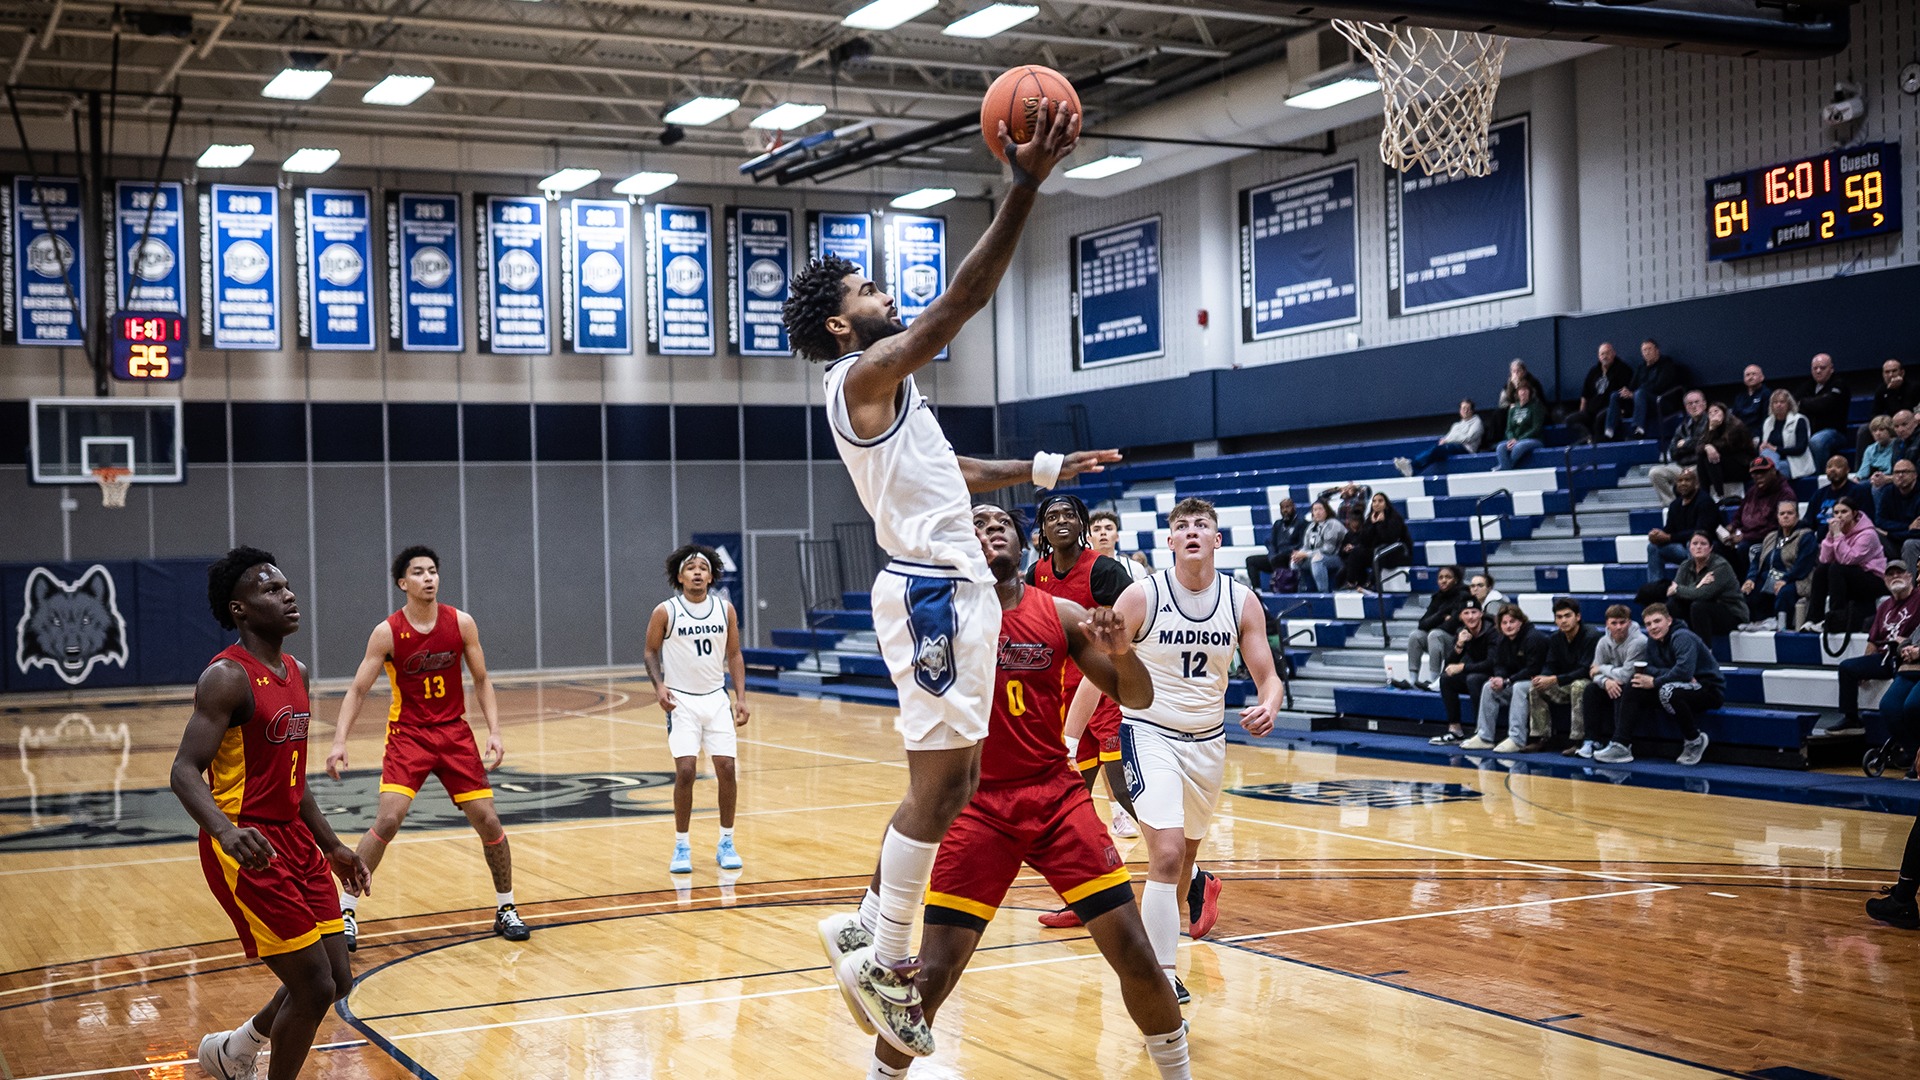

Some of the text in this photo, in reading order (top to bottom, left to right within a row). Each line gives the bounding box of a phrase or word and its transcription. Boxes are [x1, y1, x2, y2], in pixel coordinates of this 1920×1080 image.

[1840, 152, 1880, 174] Guests
[1713, 179, 1742, 199] Home
[1765, 159, 1831, 205] 16:01
[1845, 170, 1883, 214] 58
[1714, 199, 1749, 238] 64
[1821, 210, 1835, 239] 2
[1777, 221, 1810, 246] period
[129, 344, 169, 378] 25
[678, 625, 724, 636] MADISON
[1159, 630, 1231, 646] MADISON
[694, 639, 712, 656] 10
[1181, 651, 1208, 678] 12
[423, 675, 446, 699] 13
[1007, 680, 1026, 716] 0
[290, 750, 299, 787] 2
